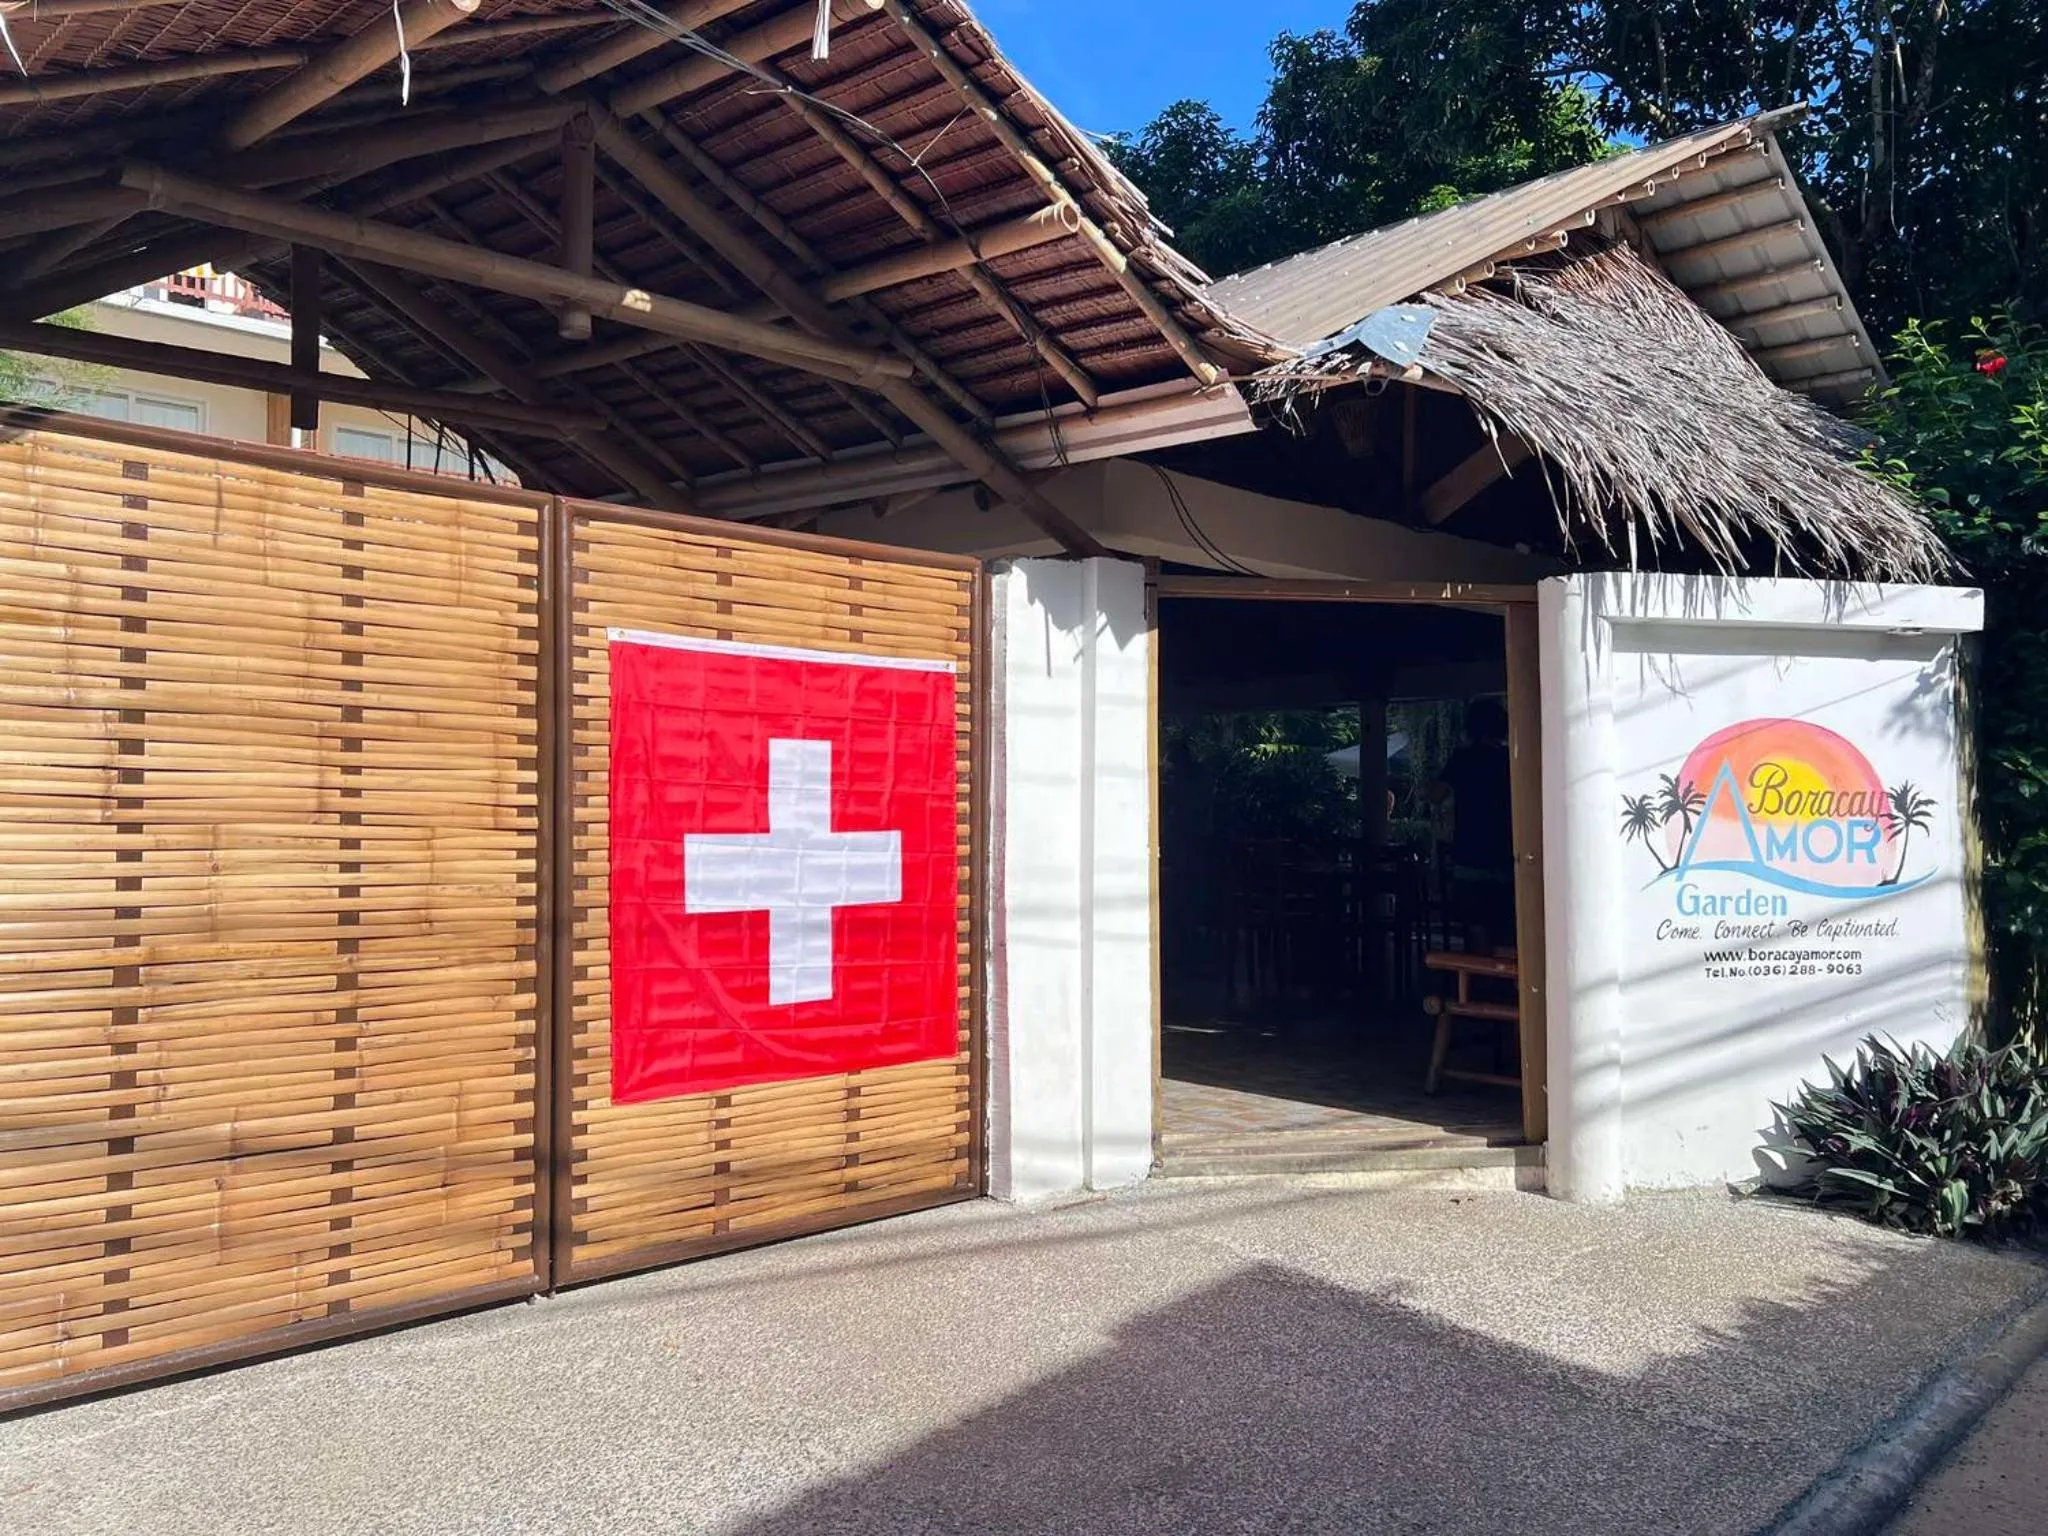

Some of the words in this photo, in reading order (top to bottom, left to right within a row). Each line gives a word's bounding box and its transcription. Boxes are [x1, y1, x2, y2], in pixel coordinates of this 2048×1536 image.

[1747, 762, 1884, 832] Boracay
[1676, 883, 1788, 917] Garden
[1787, 919, 1809, 938] Be
[1703, 948, 1862, 964] www.boracayamor.com
